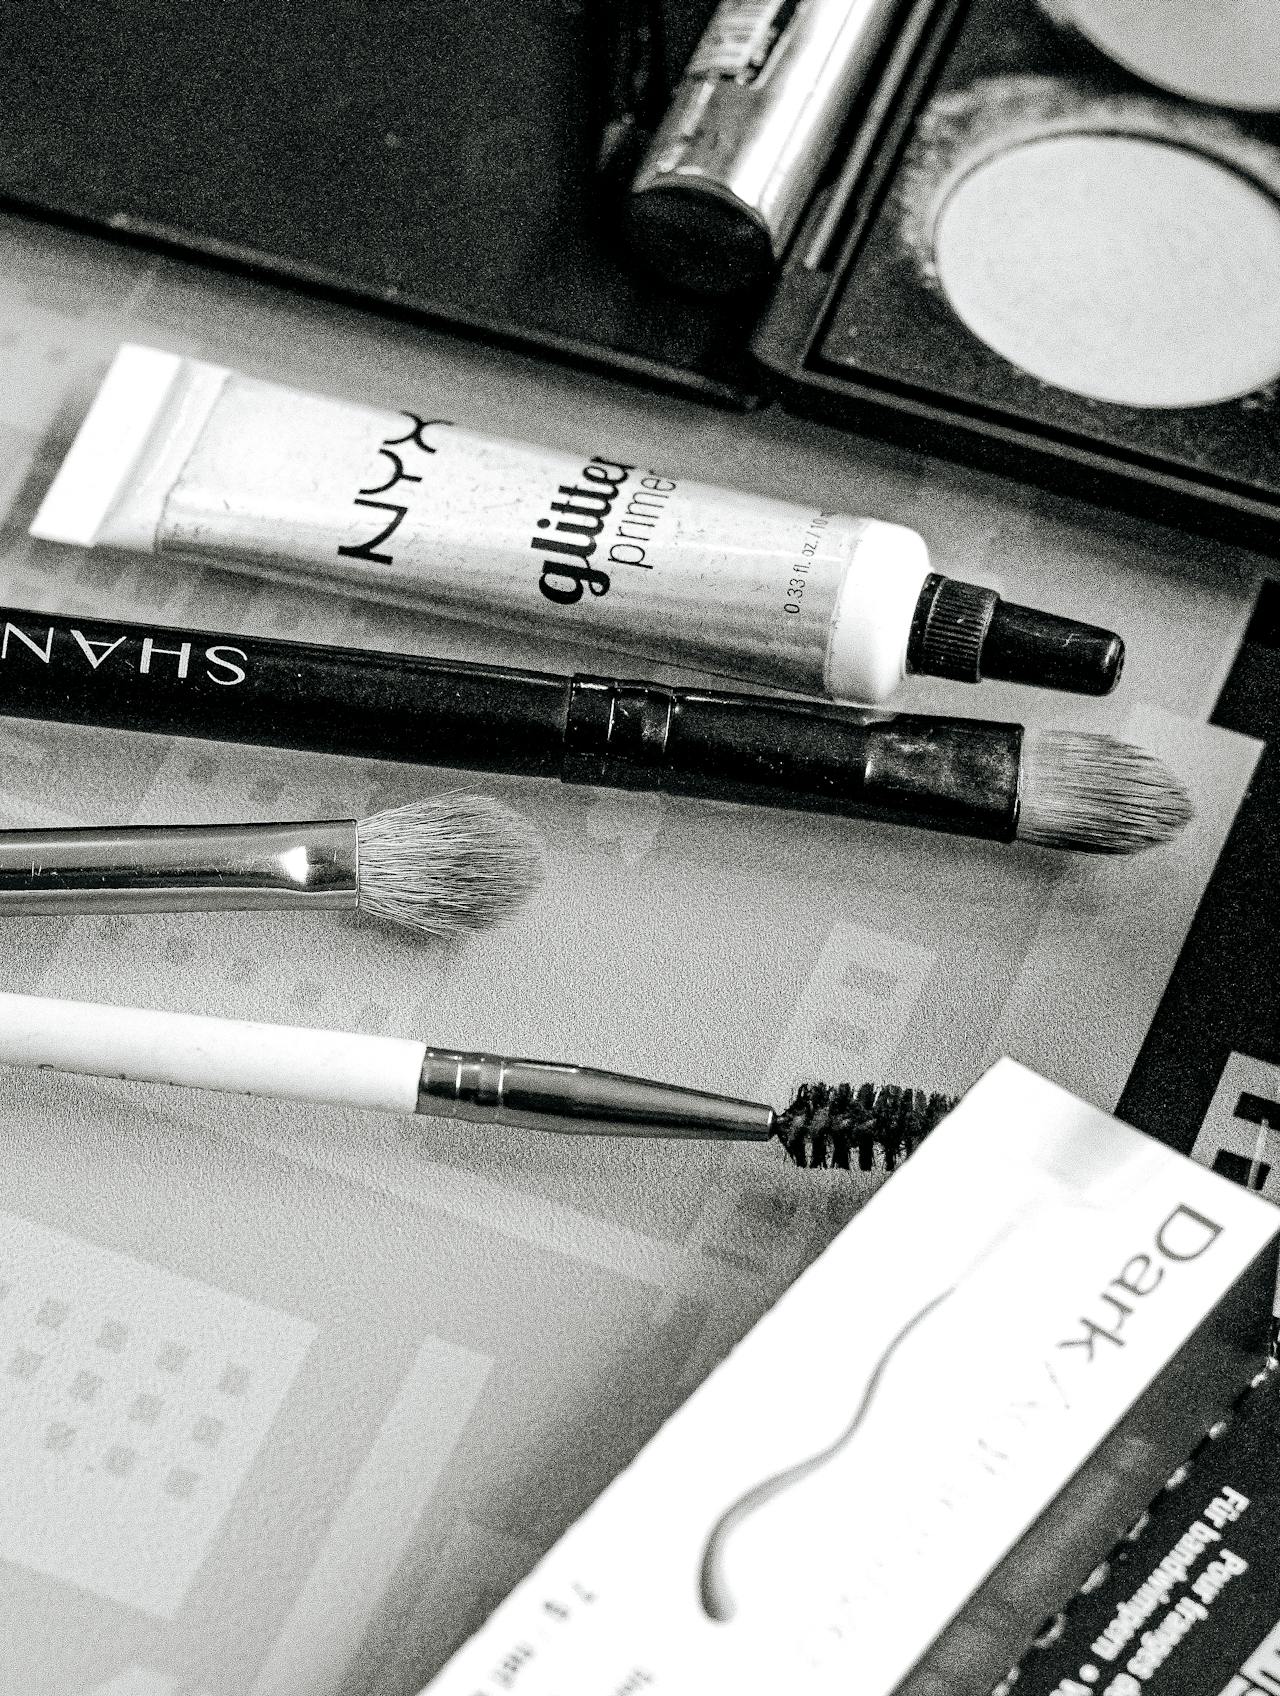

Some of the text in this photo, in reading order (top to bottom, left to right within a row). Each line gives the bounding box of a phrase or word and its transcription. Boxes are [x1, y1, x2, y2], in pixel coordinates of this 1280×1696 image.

[337, 410, 455, 565] NYX
[608, 469, 676, 569] prime
[783, 578, 806, 614] 0.33
[1057, 1202, 1224, 1363] Dark
[1191, 1548, 1250, 1605] Pour
